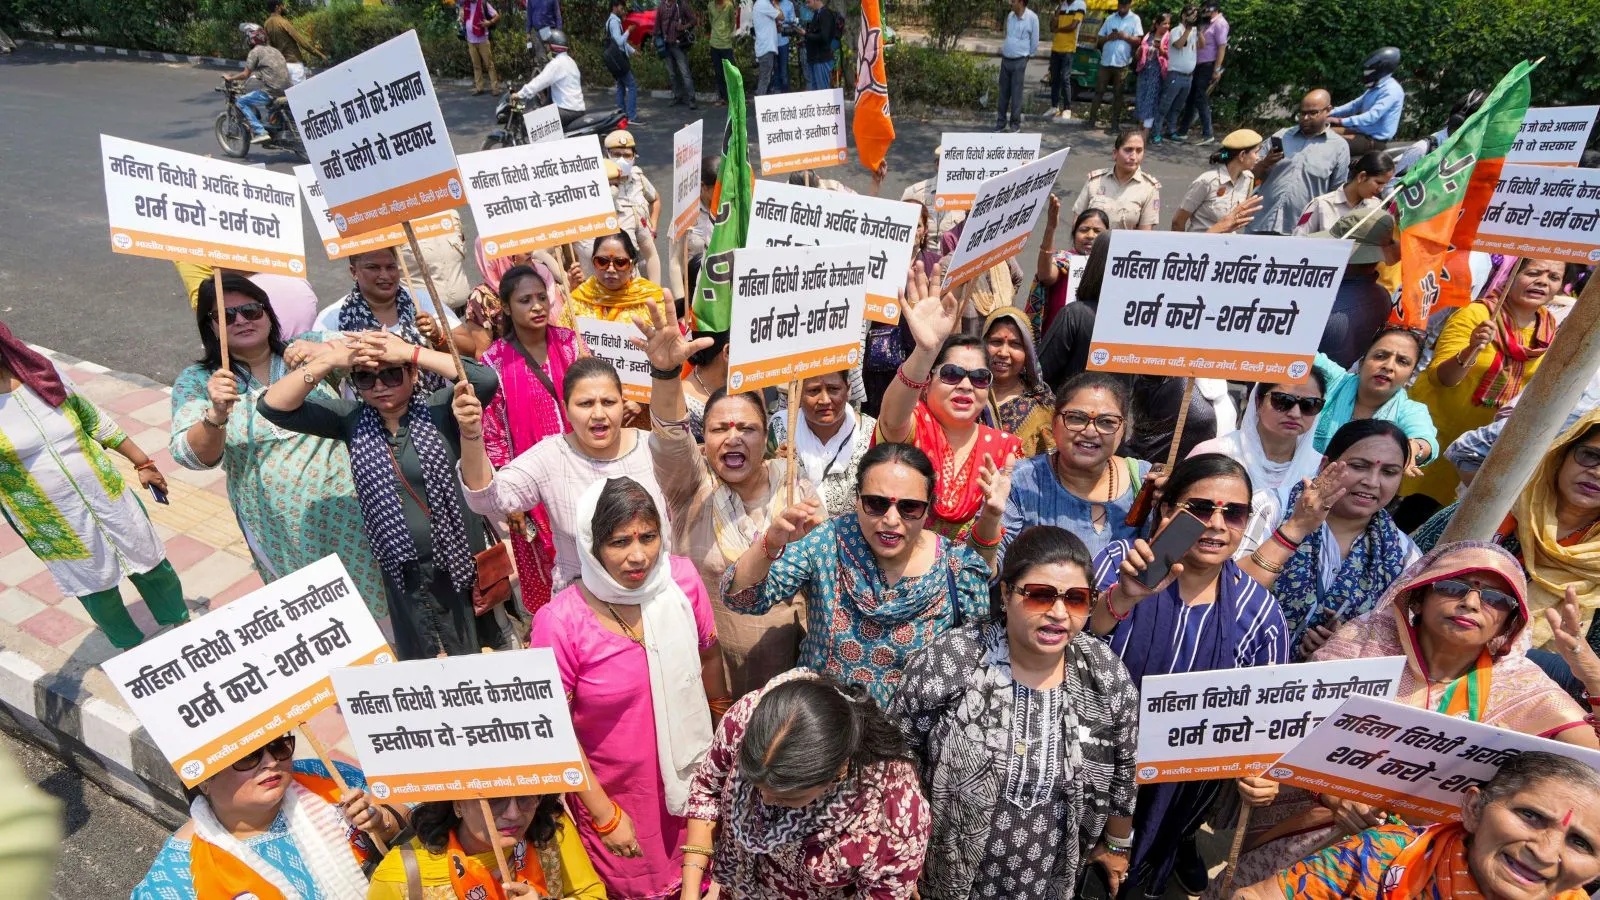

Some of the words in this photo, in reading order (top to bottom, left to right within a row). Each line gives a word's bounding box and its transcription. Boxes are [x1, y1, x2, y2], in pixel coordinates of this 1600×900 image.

[300, 100, 343, 140] महिलाओं
[340, 100, 359, 125] का
[353, 88, 371, 119] जो
[366, 81, 388, 115] करे
[384, 70, 426, 108] अपमान
[761, 109, 779, 122] महिला
[779, 107, 797, 121] विरोधी
[799, 104, 815, 118] अरविंद
[817, 103, 841, 115] केजरीवाल
[767, 129, 793, 144] इस्तीफा
[1526, 119, 1539, 133] जो
[1538, 119, 1555, 132] करे
[1553, 121, 1588, 132] अपमान
[319, 149, 345, 179] नहीं
[342, 137, 377, 172] चलेगी
[374, 132, 392, 161] वो
[389, 121, 436, 156] सरकार
[944, 146, 965, 160] महिला
[965, 146, 985, 160] विरोधी
[986, 146, 1005, 160] अरविंद
[1006, 146, 1035, 160] केजरीवाल
[1525, 138, 1537, 151] वो
[1539, 140, 1577, 151] सरकार
[108, 154, 154, 181] महिला
[157, 162, 197, 189] विरोधी
[201, 174, 239, 197] अरविंद
[241, 179, 295, 208] केजरीवाल
[469, 170, 501, 189] महिला
[500, 163, 530, 185] विरोधी
[531, 158, 559, 179] अरविंद
[559, 154, 599, 174] केजरीवाल
[946, 167, 976, 182] इस्तीफा
[1506, 176, 1541, 195] विरोधी
[1539, 178, 1577, 198] अरविंद
[1576, 178, 1600, 199] केजर
[483, 195, 528, 219] इस्तीफा
[586, 180, 600, 197] दो
[972, 193, 996, 218] महिला
[992, 182, 1016, 208] विरोधी
[1010, 175, 1033, 201] अरविंद
[1030, 167, 1059, 193] केजरीवाल
[134, 193, 168, 220] शर्म
[250, 213, 280, 239] करो
[755, 197, 789, 222] महिला
[789, 201, 822, 228] विरोधी
[823, 209, 859, 234] अरविंद
[860, 212, 912, 243] केजरीवाल
[1480, 200, 1507, 223] र्म
[1568, 209, 1600, 231] करो
[965, 220, 990, 252] शर्म
[738, 268, 770, 297] महिला
[771, 264, 799, 294] विरोधी
[800, 262, 828, 290] अरविंद
[829, 261, 865, 288] केजरीवाल
[867, 250, 888, 280] रो
[1111, 250, 1160, 280] महिला
[1161, 251, 1210, 282] विरोधी
[1210, 254, 1262, 284] अरविंद
[1262, 256, 1339, 288] केजरीवाल
[750, 306, 775, 344] शर्म
[828, 297, 850, 330] करो
[1123, 293, 1165, 327] शर्म
[1256, 300, 1300, 335] करो
[580, 331, 599, 346] हिला
[600, 333, 621, 348] विरोधी
[615, 356, 651, 374] दो-इस्ती
[124, 658, 186, 699] महिला
[181, 629, 236, 673] विरोधी
[234, 605, 285, 646] अरविंद
[279, 576, 350, 621] केजरीवाल
[177, 681, 225, 728] शर्म
[308, 617, 352, 656] करो
[346, 690, 393, 715] महिला
[392, 684, 437, 712] विरोधी
[438, 679, 484, 708] अरविंद
[483, 676, 553, 704] केजरीवाल
[1147, 690, 1198, 713] महिला
[1202, 684, 1252, 709] विरोधी
[1255, 679, 1308, 704] अरविंद
[367, 725, 435, 754] इस्तीफा
[531, 714, 554, 738] दो
[1168, 718, 1208, 747] शर्म
[1333, 713, 1402, 739] महिला
[1394, 726, 1467, 754] विरोधी
[1456, 744, 1521, 767] अरवि
[392, 783, 421, 794] भारतीय
[421, 783, 446, 792] जनता
[466, 778, 495, 789] महिला
[516, 773, 540, 785] दिल्ली
[541, 773, 562, 784] प्रदेश
[1325, 746, 1390, 770] शर्म
[1377, 757, 1489, 795] करो-श
